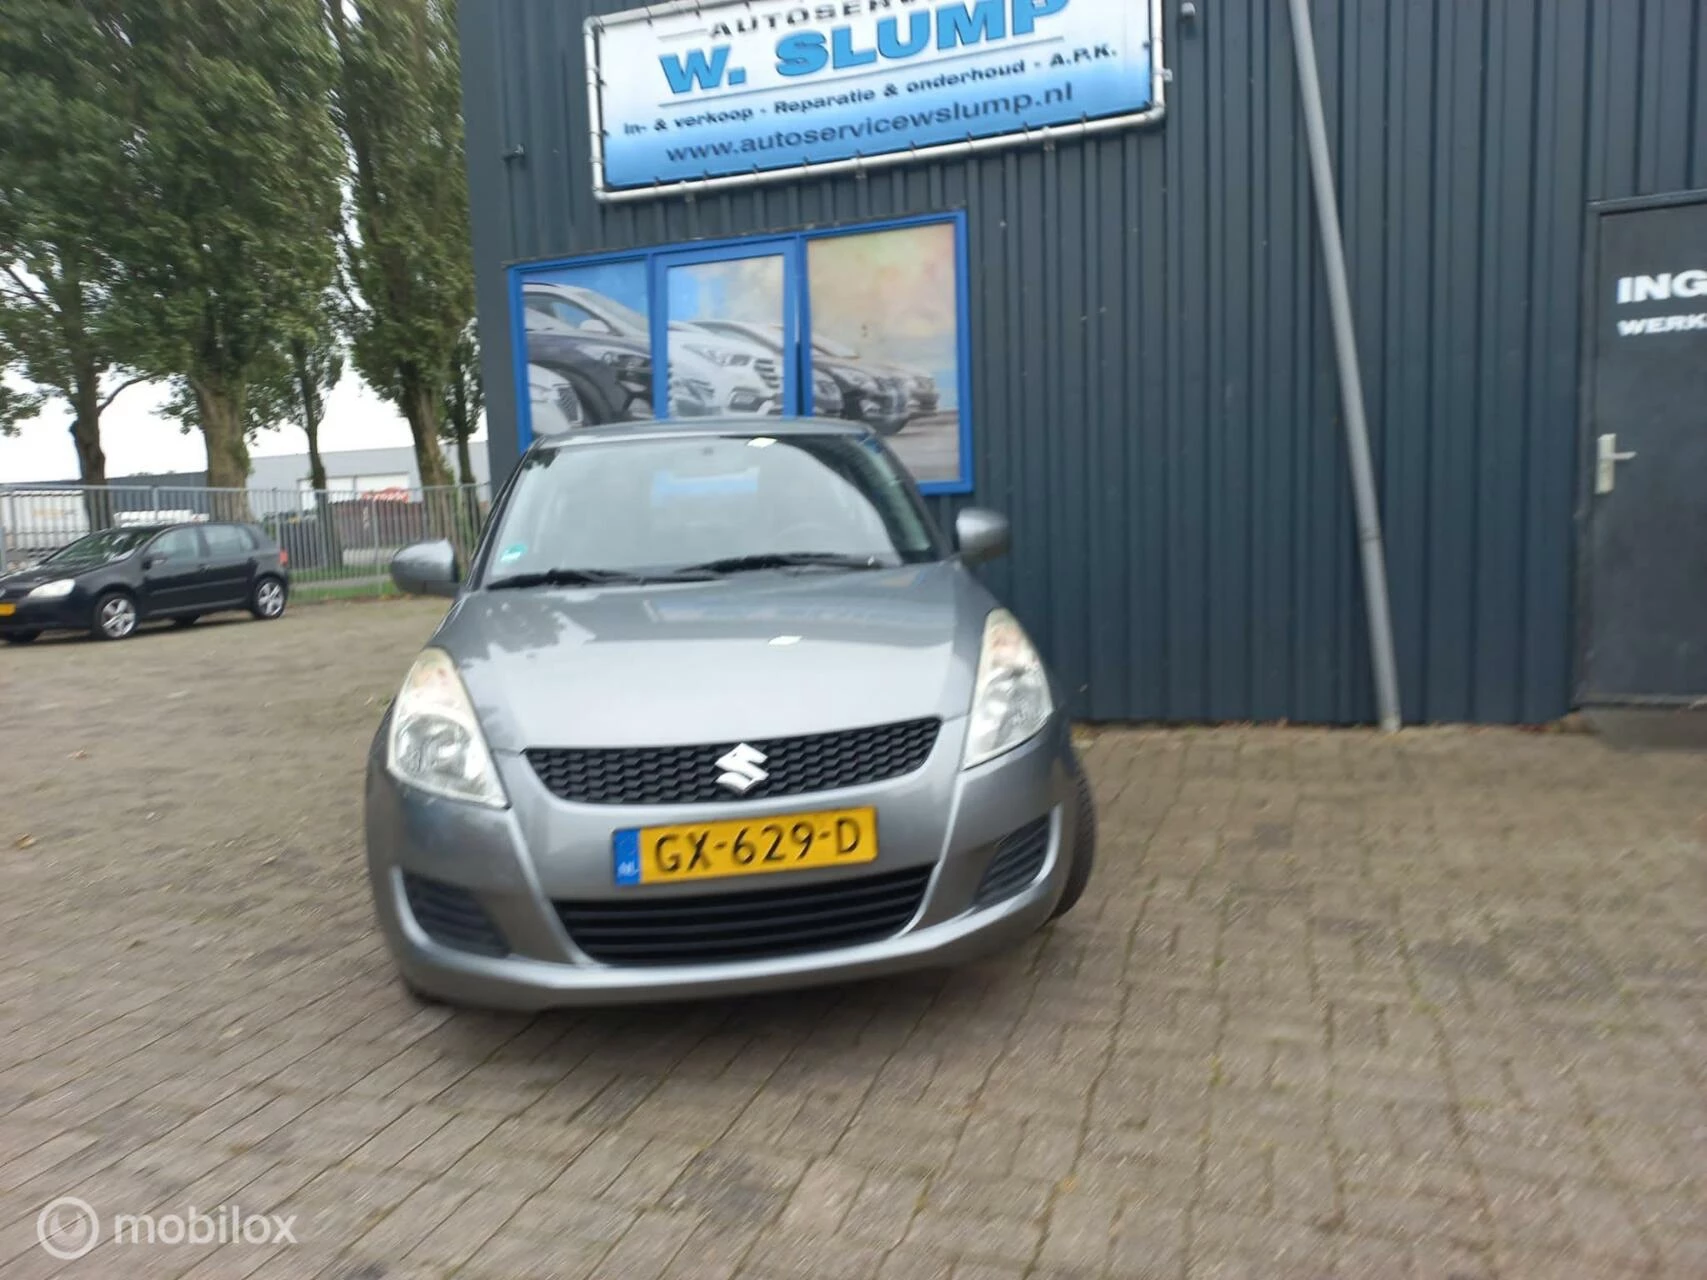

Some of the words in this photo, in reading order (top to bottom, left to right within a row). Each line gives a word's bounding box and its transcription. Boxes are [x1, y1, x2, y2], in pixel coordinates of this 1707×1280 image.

[659, 42, 746, 94] W.
[775, 0, 1070, 78] SLUMP
[654, 117, 668, 132] &
[674, 107, 754, 130] verkoop
[773, 86, 876, 115] Reparatie
[883, 83, 899, 97] &
[907, 60, 1026, 94] onderhoud
[665, 81, 1074, 162] www.autoservicewslump.nl
[655, 816, 861, 873] GX-629-D
